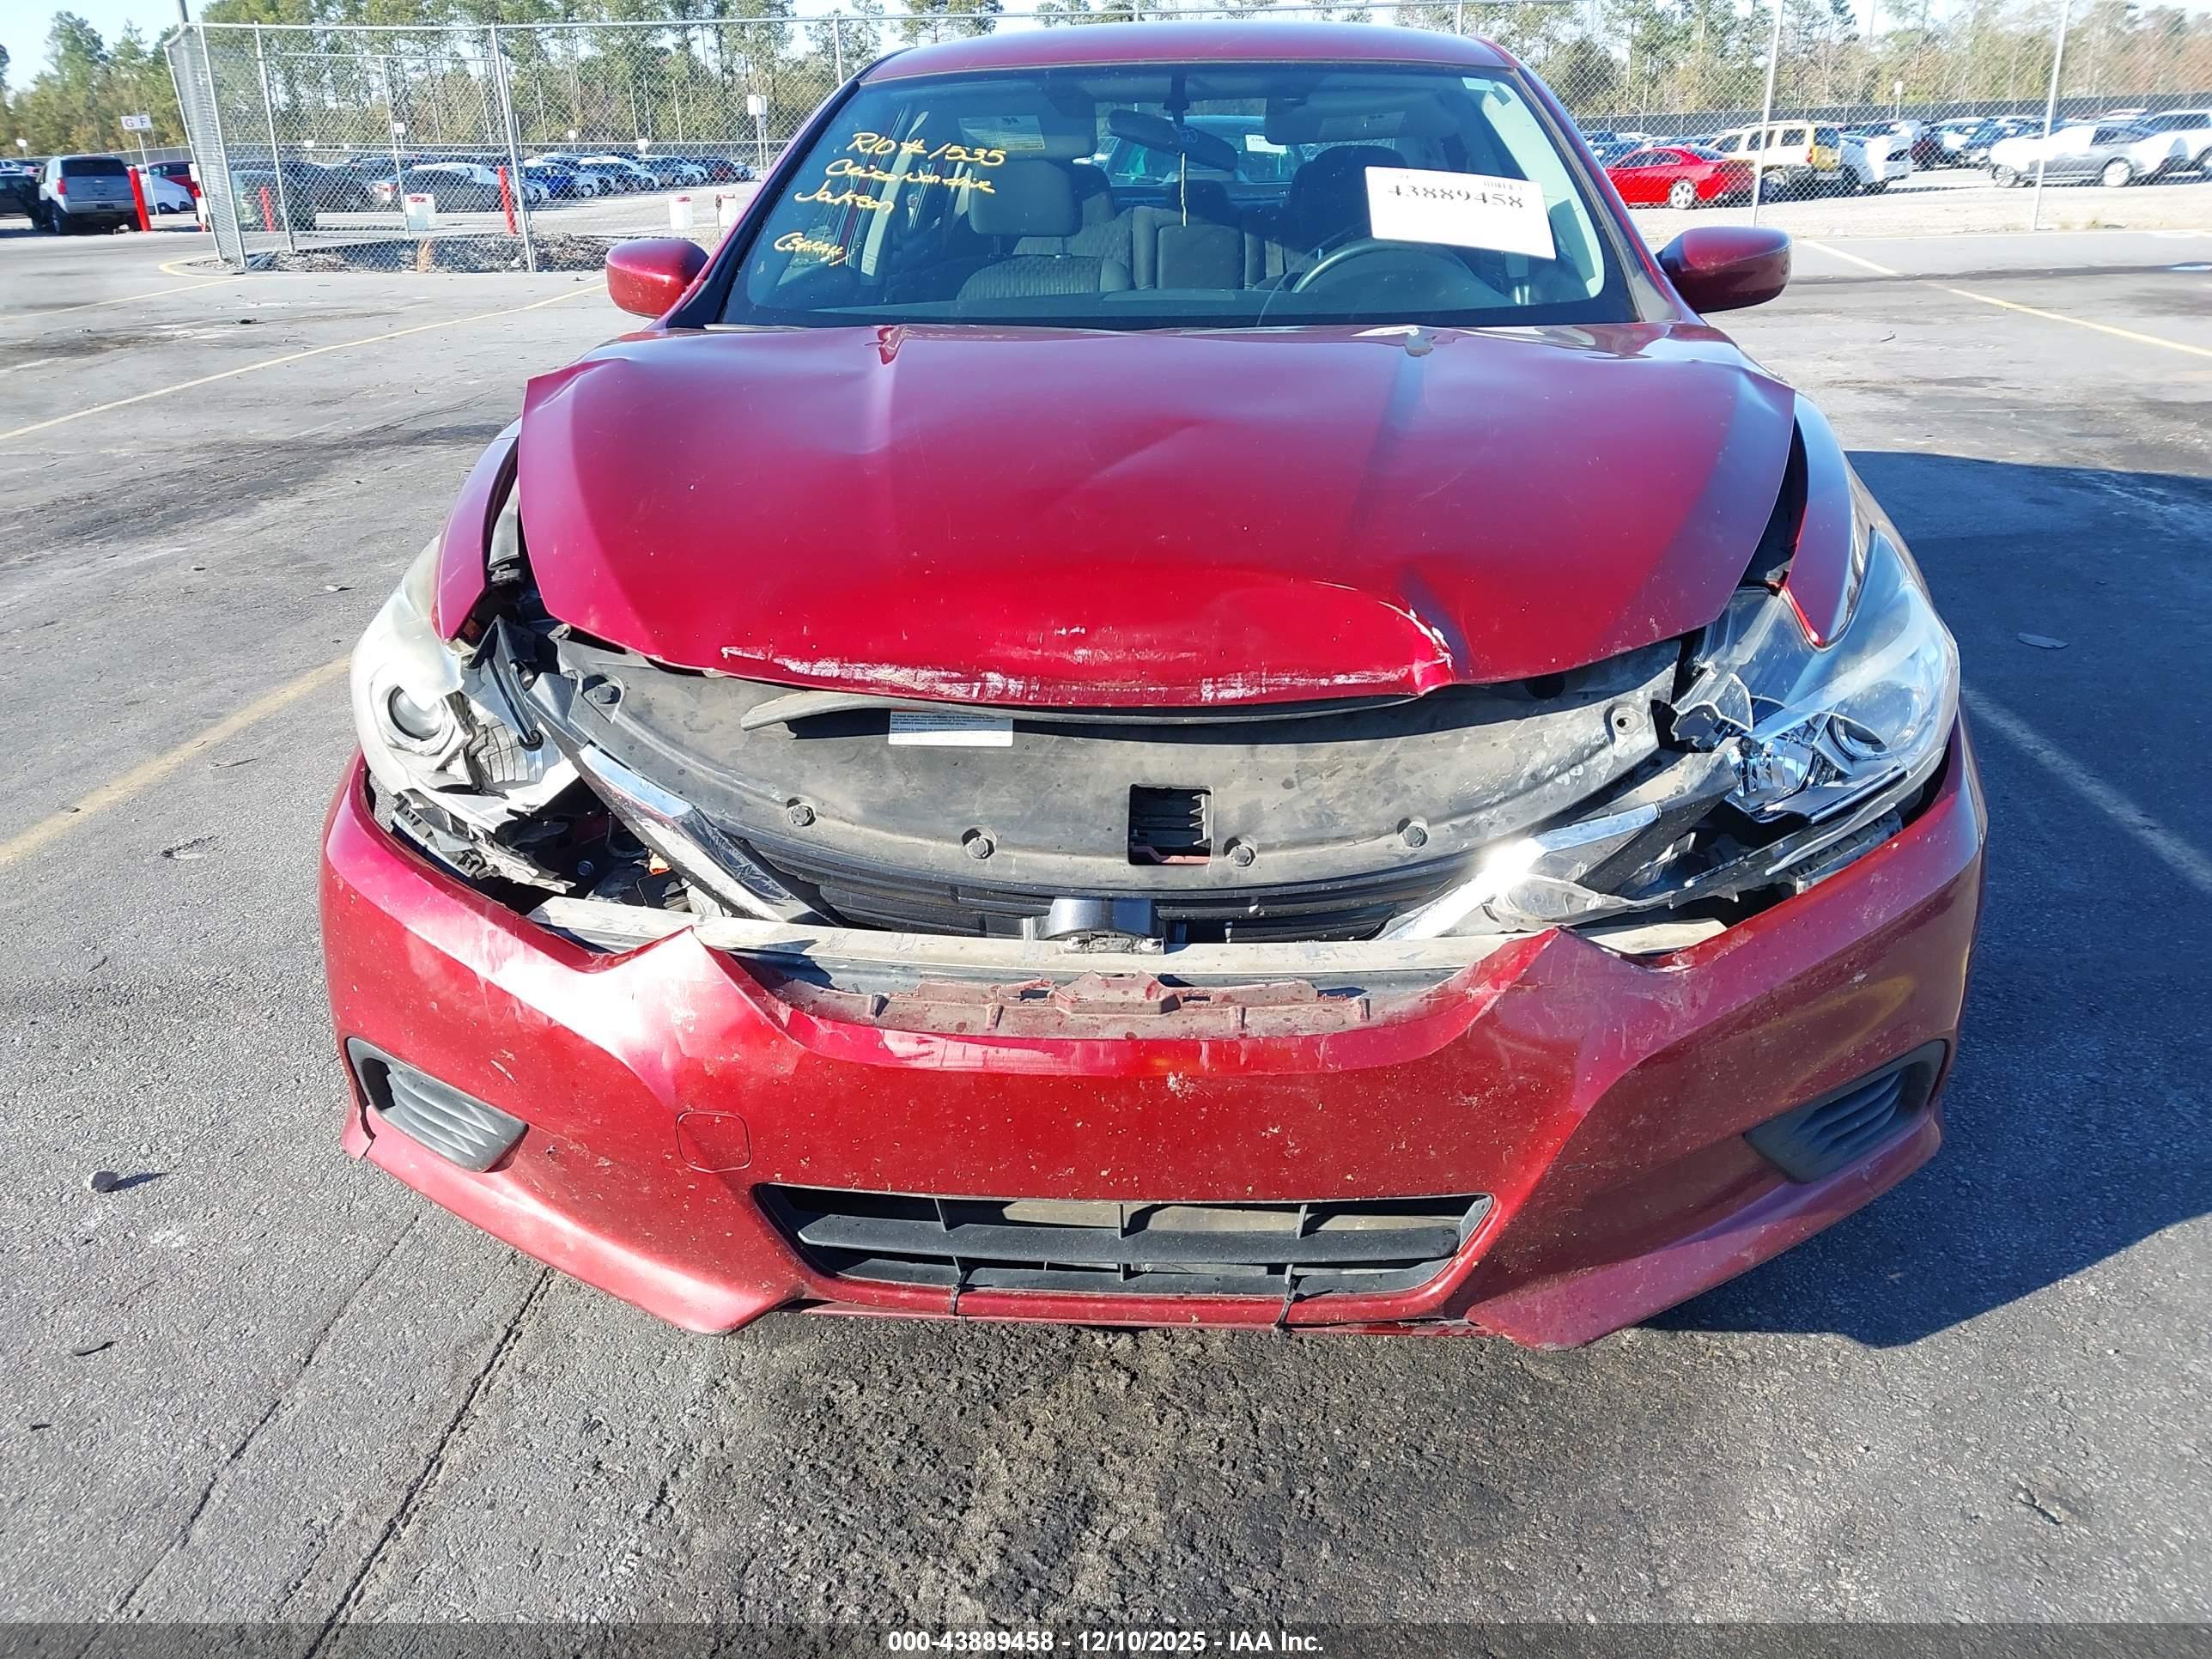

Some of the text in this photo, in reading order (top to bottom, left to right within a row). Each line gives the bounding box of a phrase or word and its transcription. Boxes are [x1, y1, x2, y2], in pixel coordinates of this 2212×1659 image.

[125, 117, 147, 128] G F
[900, 137, 927, 155] #
[928, 143, 1006, 167] 1535
[1388, 184, 1524, 209] 43889458
